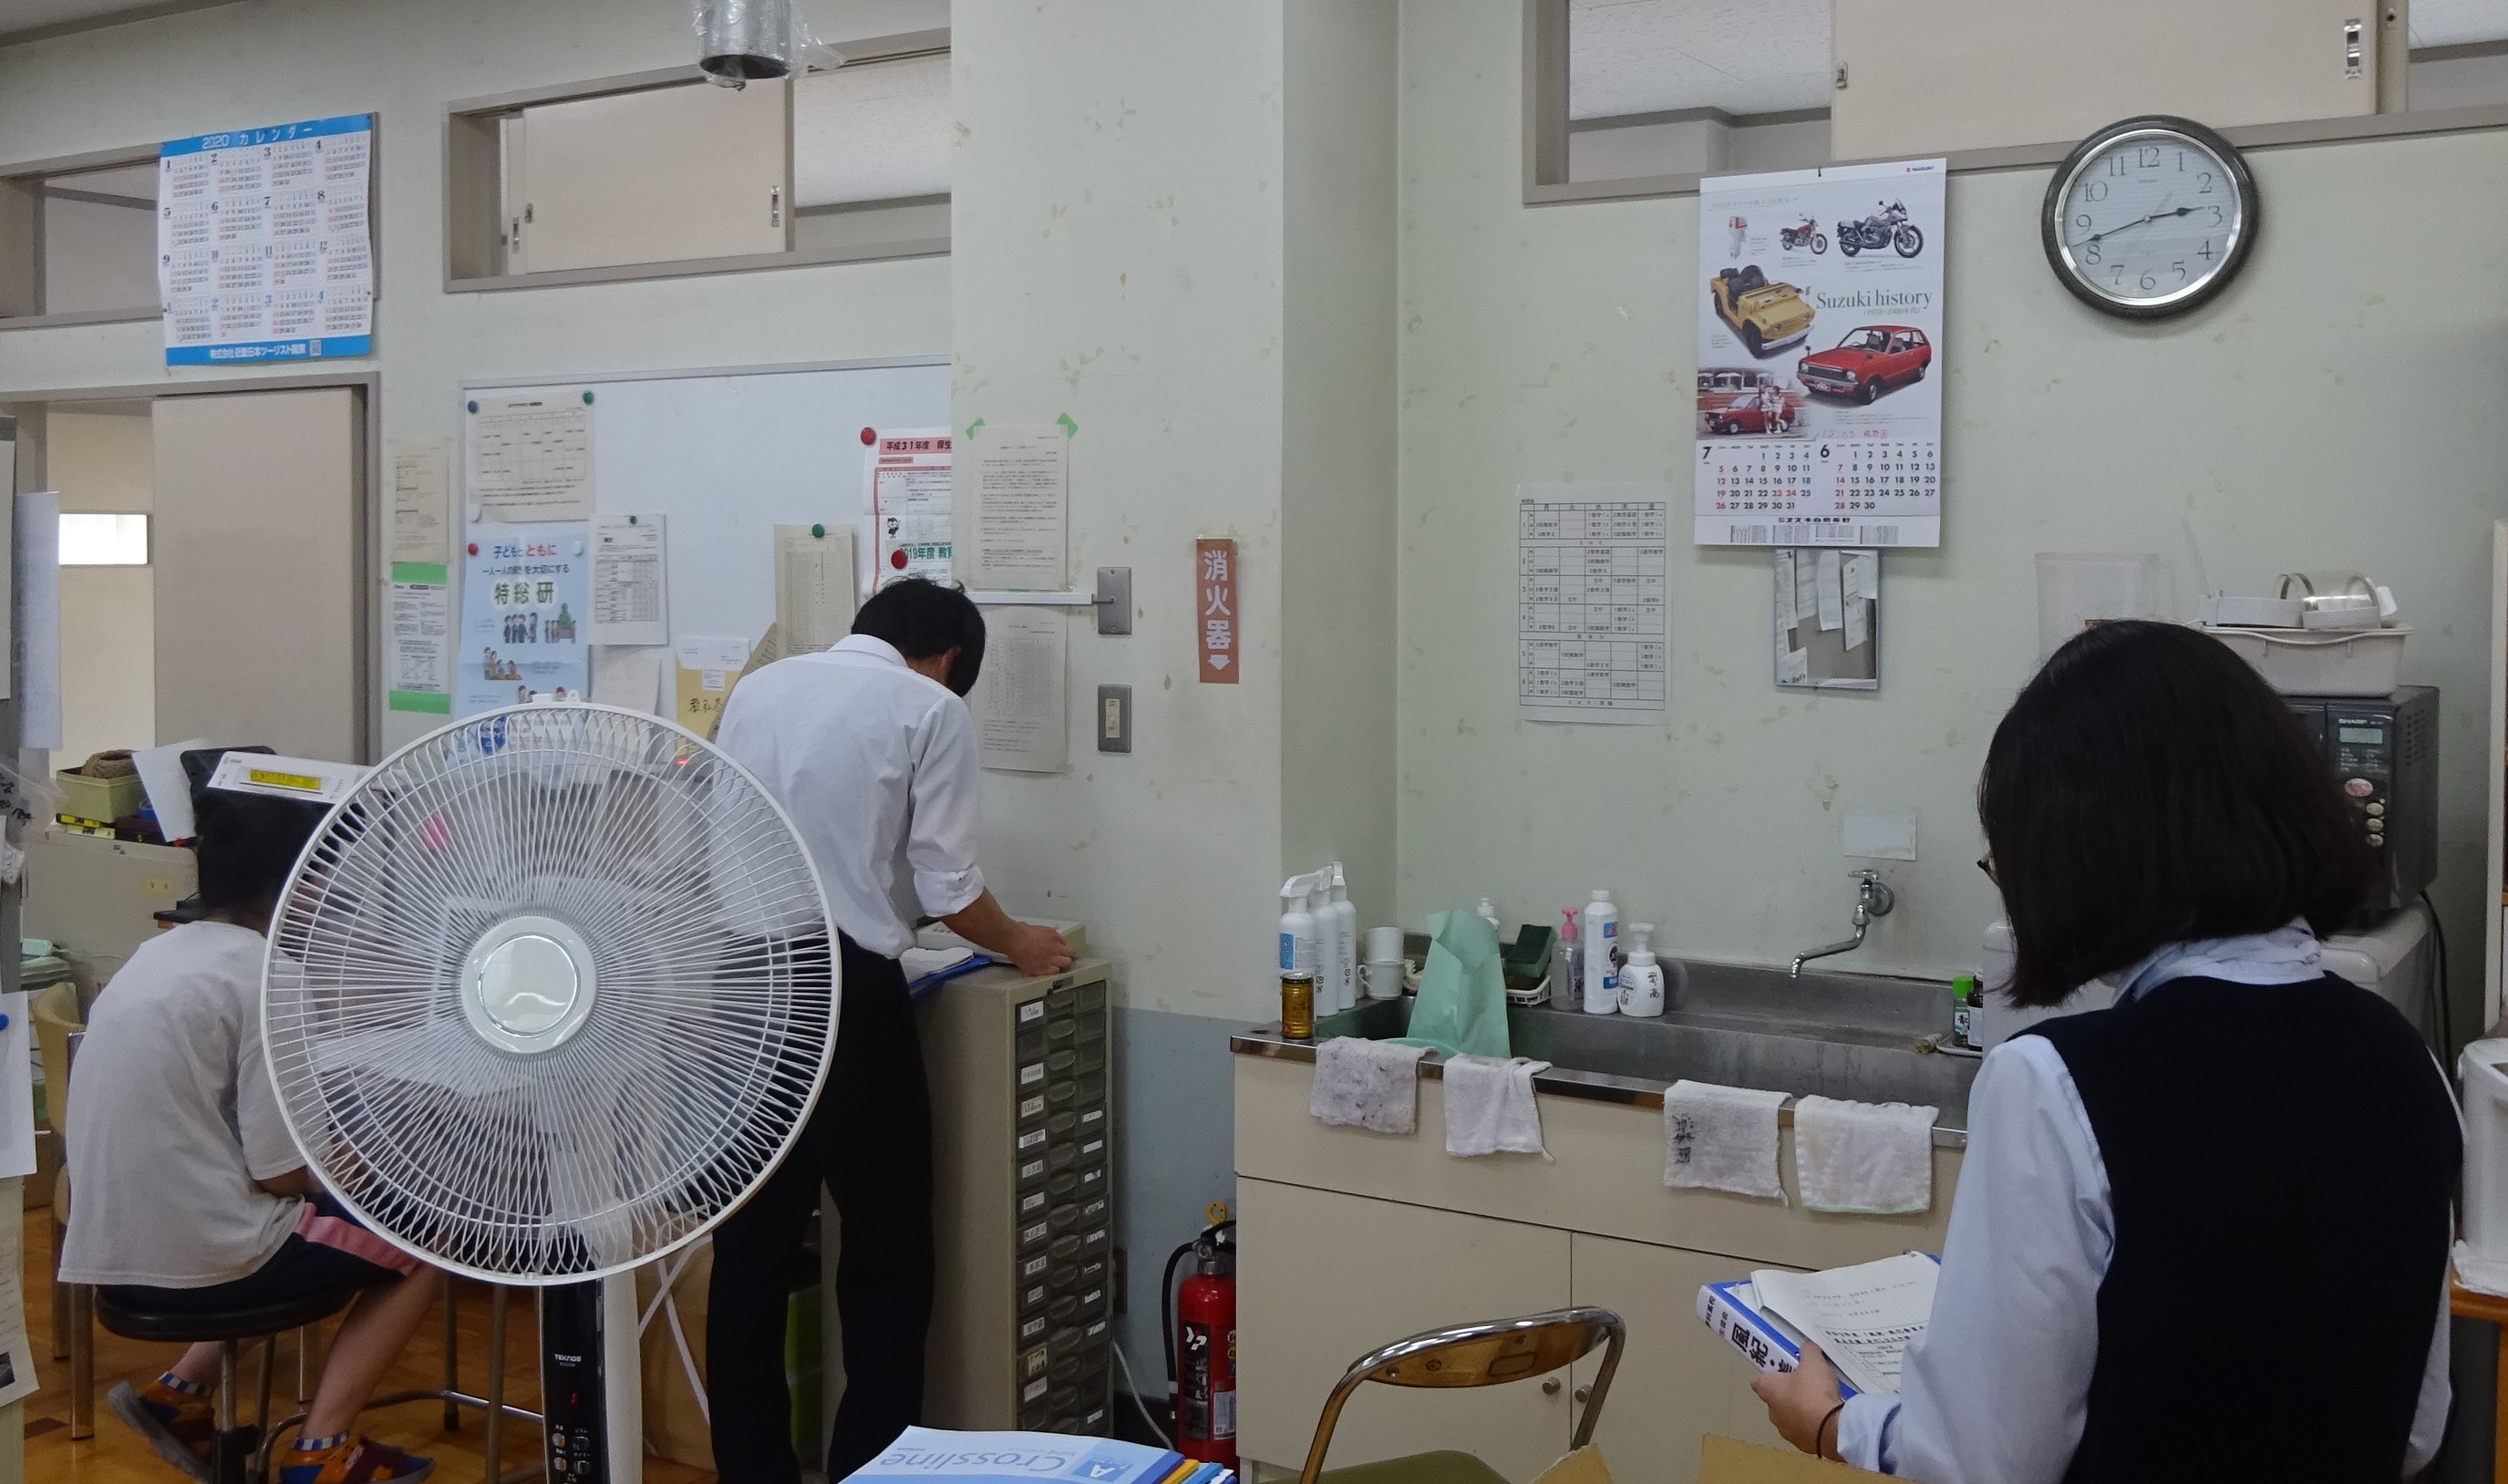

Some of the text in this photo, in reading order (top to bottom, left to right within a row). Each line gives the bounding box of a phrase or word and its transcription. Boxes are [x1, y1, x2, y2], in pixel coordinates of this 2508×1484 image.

[201, 124, 313, 149] 2020 カレンダー
[2109, 156, 2127, 176] 11
[2137, 147, 2160, 168] 12
[2179, 151, 2185, 171] 1
[2085, 180, 2108, 202] 10
[2197, 172, 2213, 193] 2
[164, 191, 325, 216] 5 6 7 8
[2076, 214, 2091, 234] 9
[2207, 206, 2223, 227] 3
[2085, 245, 2100, 264] 8
[2197, 240, 2214, 260] 4
[2111, 264, 2124, 284] 7
[2140, 270, 2156, 290] 6
[2173, 261, 2186, 281] 5
[1816, 289, 1932, 309] Suzuki history
[1703, 447, 1712, 459] 7
[1821, 445, 1830, 458] 6
[899, 547, 934, 560] 019年度
[494, 582, 554, 604] 特総研
[1203, 550, 1231, 649] 消火器
[554, 1353, 582, 1362] TEKNOS
[880, 1451, 1066, 1472] Crossline
[1089, 1464, 1115, 1478] A
